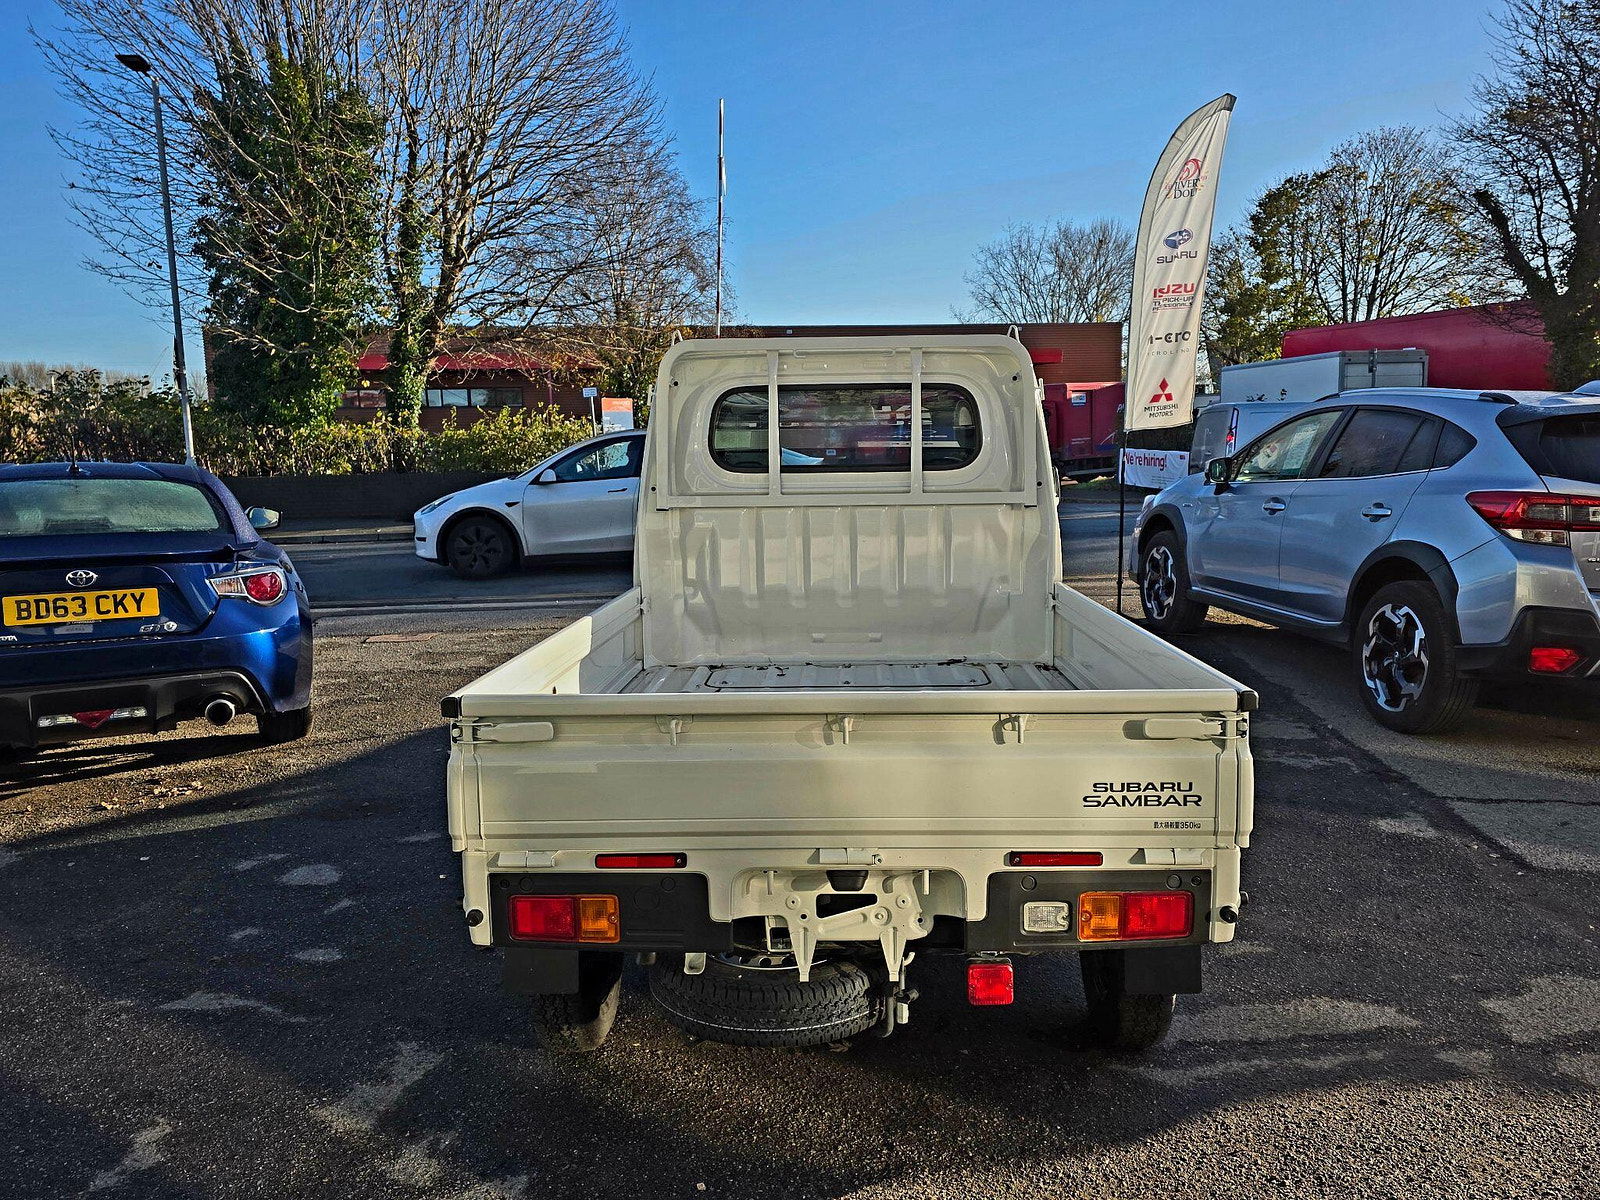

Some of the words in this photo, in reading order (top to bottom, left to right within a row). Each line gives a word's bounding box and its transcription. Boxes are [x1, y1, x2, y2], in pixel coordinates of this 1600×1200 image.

[1156, 250, 1198, 264] SURU
[1149, 410, 1173, 418] MOTORS
[1143, 453, 1167, 471] hiring!
[15, 595, 87, 620] BD63
[95, 592, 145, 615] CKY
[1092, 782, 1193, 793] SUBARU
[1083, 795, 1203, 808] SAMBAR
